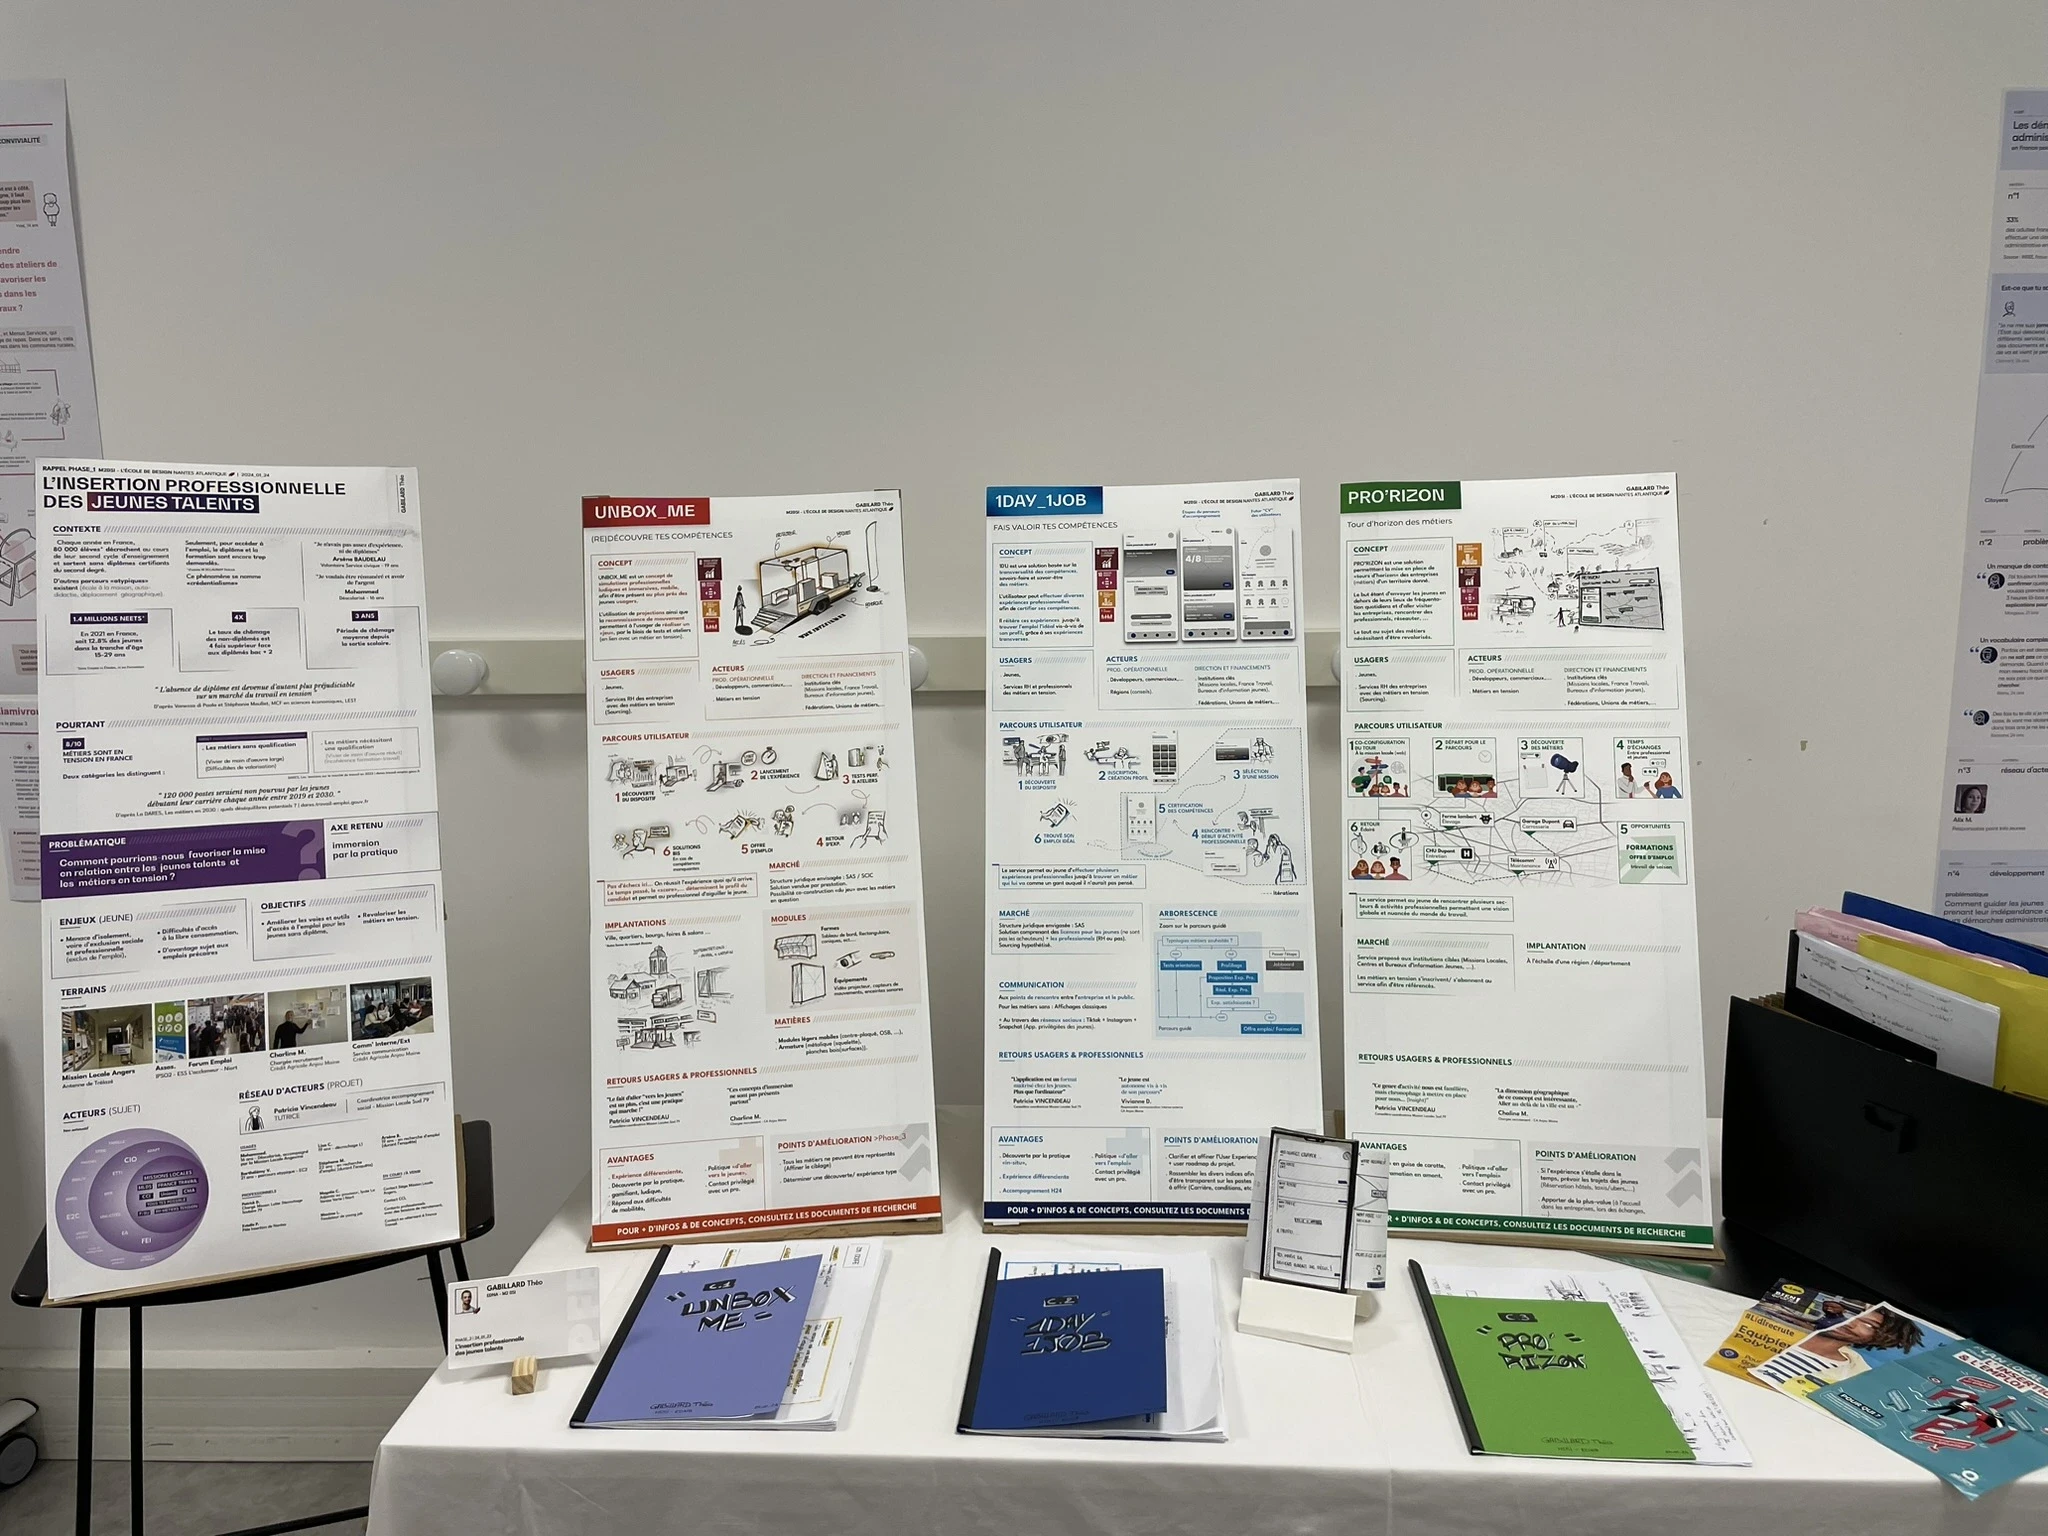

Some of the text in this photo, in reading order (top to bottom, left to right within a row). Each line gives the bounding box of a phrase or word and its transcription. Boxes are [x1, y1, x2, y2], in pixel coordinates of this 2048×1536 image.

[2013, 121, 2029, 130] Les
[4, 290, 23, 298] dans
[42, 477, 346, 495] L'INSERTION PROFESSIONNELLE
[996, 494, 1087, 509] 1DAY_1JOB
[1348, 488, 1445, 505] PRO'RIZON
[43, 495, 255, 512] DES JEUNES TALENTS
[594, 505, 696, 519] UNBOX_ME
[52, 525, 102, 533] CONTEXTE
[1011, 523, 1042, 531] VALOIR
[1059, 520, 1118, 529] COMPÉTENCES
[1347, 518, 1453, 529] Tour d'horizon des métiers
[591, 531, 733, 544] (RE)DÉCOUVRE TES COMPÉTENCES
[1353, 545, 1388, 553] CONCEPT
[1185, 554, 1202, 563] 4/8
[1106, 655, 1138, 663] ACTEURS
[1467, 654, 1502, 662] ACTEURS
[600, 669, 635, 677] USAGERS
[712, 665, 744, 673] ACTEURS
[55, 720, 106, 729] POURTANT
[602, 733, 690, 743] PARCOURS UTILISATEUR
[65, 740, 82, 748] 8/10
[350, 822, 383, 830] RETENU
[48, 837, 126, 849] PROBLÉMATIQUE
[59, 858, 108, 868] Comment
[188, 849, 231, 859] favoriser
[232, 848, 242, 856] la
[243, 847, 266, 855] mise
[333, 852, 348, 860] par
[360, 848, 398, 858] pratique
[74, 866, 112, 877] relation
[114, 866, 140, 874] entre
[142, 864, 156, 873] les
[160, 862, 191, 873] jeunes
[193, 859, 226, 868] talents
[769, 859, 800, 869] MARCHÉ
[59, 879, 74, 888] les
[78, 876, 116, 887] métiers
[132, 873, 168, 883] tension
[169, 873, 176, 881] ?
[260, 899, 307, 911] OBJECTIFS
[999, 908, 1030, 917] MARCHÉ
[59, 913, 134, 926] ENJEUX (JEUNE)
[771, 914, 807, 923] MODULES
[605, 919, 667, 930] IMPLANTATIONS
[1357, 937, 1390, 946] MARCHÉ
[1526, 942, 1586, 951] IMPLANTATION
[999, 981, 1064, 989] COMMUNICATION
[61, 985, 107, 997] TERRAINS
[774, 1016, 811, 1025] MATIÈRES
[62, 1072, 85, 1081] Mission
[607, 1076, 642, 1086] RETOURS
[643, 1073, 680, 1082] USAGERS
[690, 1067, 758, 1079] PROFESSIONNELS
[239, 1078, 363, 1100] RÉSEAU D'ACTEURS (PROJET)
[63, 1104, 141, 1120] ACTEURS (SUJET)
[778, 1140, 806, 1150] POINTS
[808, 1135, 872, 1147] D'AMÉLIORATION
[1163, 1134, 1258, 1145] POINTS D'AMÉLIORATION
[1360, 1142, 1407, 1151] AVANTAGES
[607, 1154, 655, 1164] AVANTAGES
[1535, 1149, 1636, 1162] POINTS D'AMÉLIORATION
[617, 1227, 640, 1236] POUR
[648, 1223, 680, 1234] D'INFOS
[682, 1221, 688, 1229] &
[690, 1220, 700, 1228] DE
[701, 1217, 747, 1228] CONCEPTS,
[749, 1212, 794, 1223] CONSULTEZ
[795, 1210, 810, 1219] LES
[811, 1207, 860, 1219] DOCUMENTS
[861, 1205, 871, 1213] DE
[873, 1202, 917, 1212] RECHERCHE
[1401, 1215, 1686, 1237] D'INFOS & DE CONCEPTS, CONSULTEZ LES DOCUMENTS DE RECHERCHE
[486, 1281, 526, 1292] GABILLARD
[698, 1312, 747, 1332] ME
